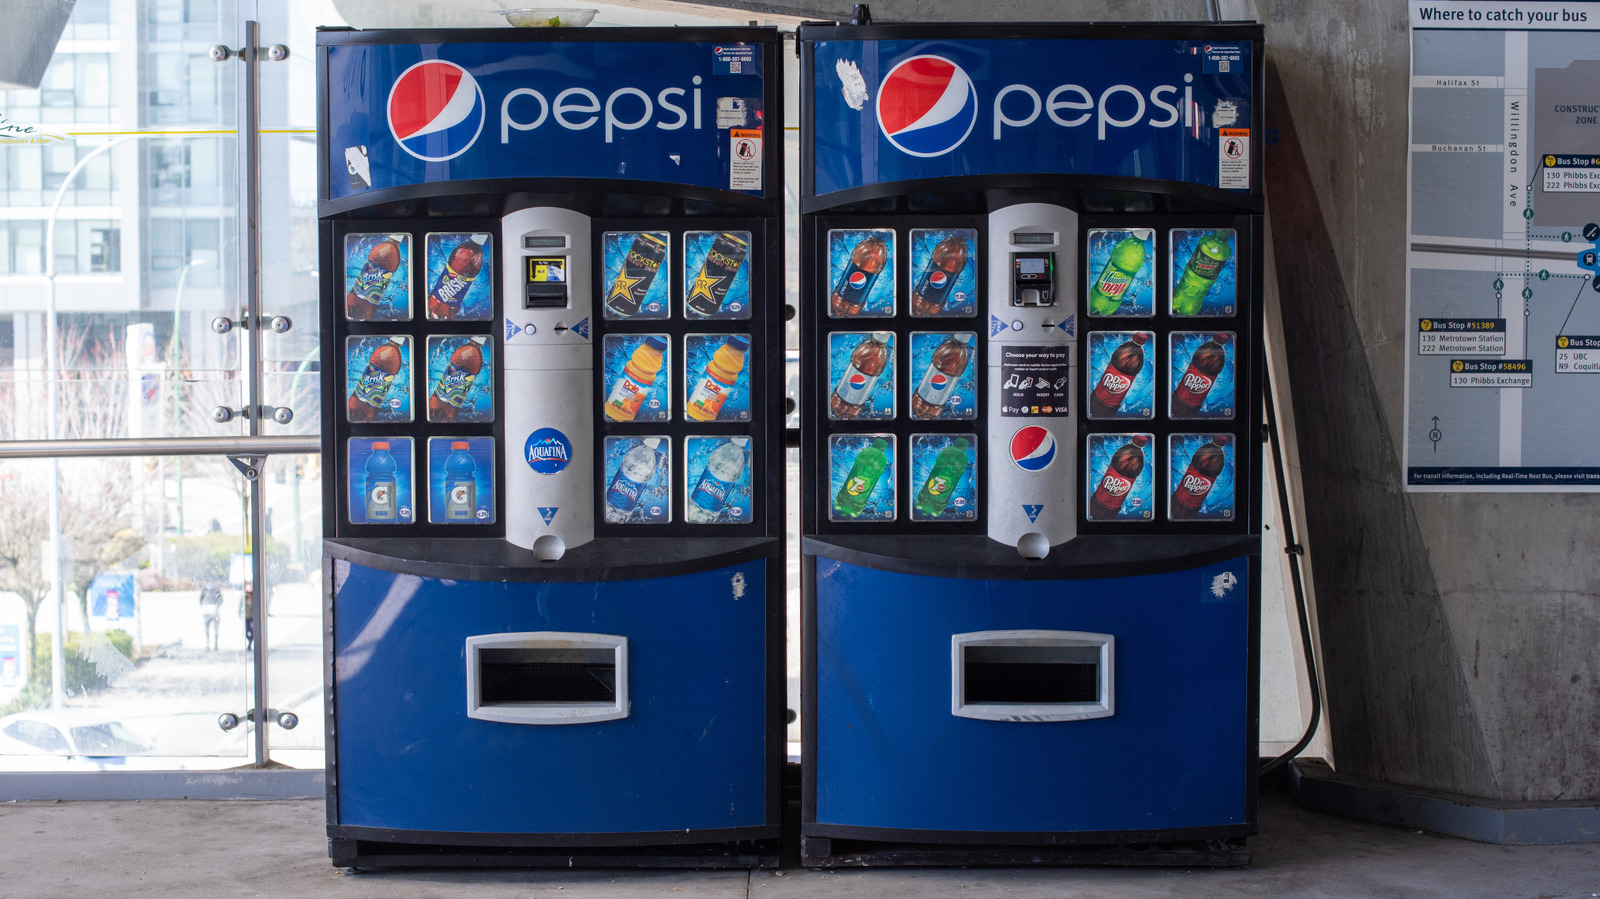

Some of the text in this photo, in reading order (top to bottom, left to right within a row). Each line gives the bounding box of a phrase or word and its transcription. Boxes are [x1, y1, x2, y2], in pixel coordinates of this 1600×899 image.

[1419, 7, 1587, 24] Where to catch your bus
[501, 75, 702, 143] pepsi
[993, 73, 1194, 140] pepsi
[1554, 104, 1600, 113] CONSTRUC
[1575, 116, 1597, 124] ZONE
[1432, 144, 1486, 152] Buchanan St
[1508, 101, 1520, 207] Willingdon Ave
[1557, 157, 1600, 166] Bus Stop #6
[1546, 171, 1560, 179] 130
[1563, 171, 1587, 179] Phibbs
[1563, 181, 1587, 189] Phibbs
[438, 275, 467, 303] BRISK
[1448, 321, 1465, 331] Stop
[1466, 321, 1495, 329] #51389
[1439, 334, 1477, 342] Metrotown
[1478, 334, 1504, 342] Station
[1439, 344, 1477, 352] Metrotown
[1478, 344, 1504, 352] Station
[1585, 339, 1600, 348] Stop
[1479, 363, 1496, 372] Stop
[1104, 373, 1130, 390] Pepper
[1113, 375, 1124, 384] Dr
[1184, 373, 1210, 390] Pepper
[1194, 375, 1206, 384] Dr
[1497, 377, 1530, 386] Exchange
[624, 379, 639, 393] Dole
[705, 379, 721, 393] Dole
[1008, 406, 1019, 414] Pay
[528, 445, 567, 461] AQUAFINA
[1104, 475, 1130, 492] Pepper
[1113, 477, 1124, 486] Dr
[1184, 475, 1210, 491] Pepper
[1194, 477, 1205, 486] Dr
[612, 479, 638, 501] AQUAFINA
[699, 479, 726, 501] AQUAFINA
